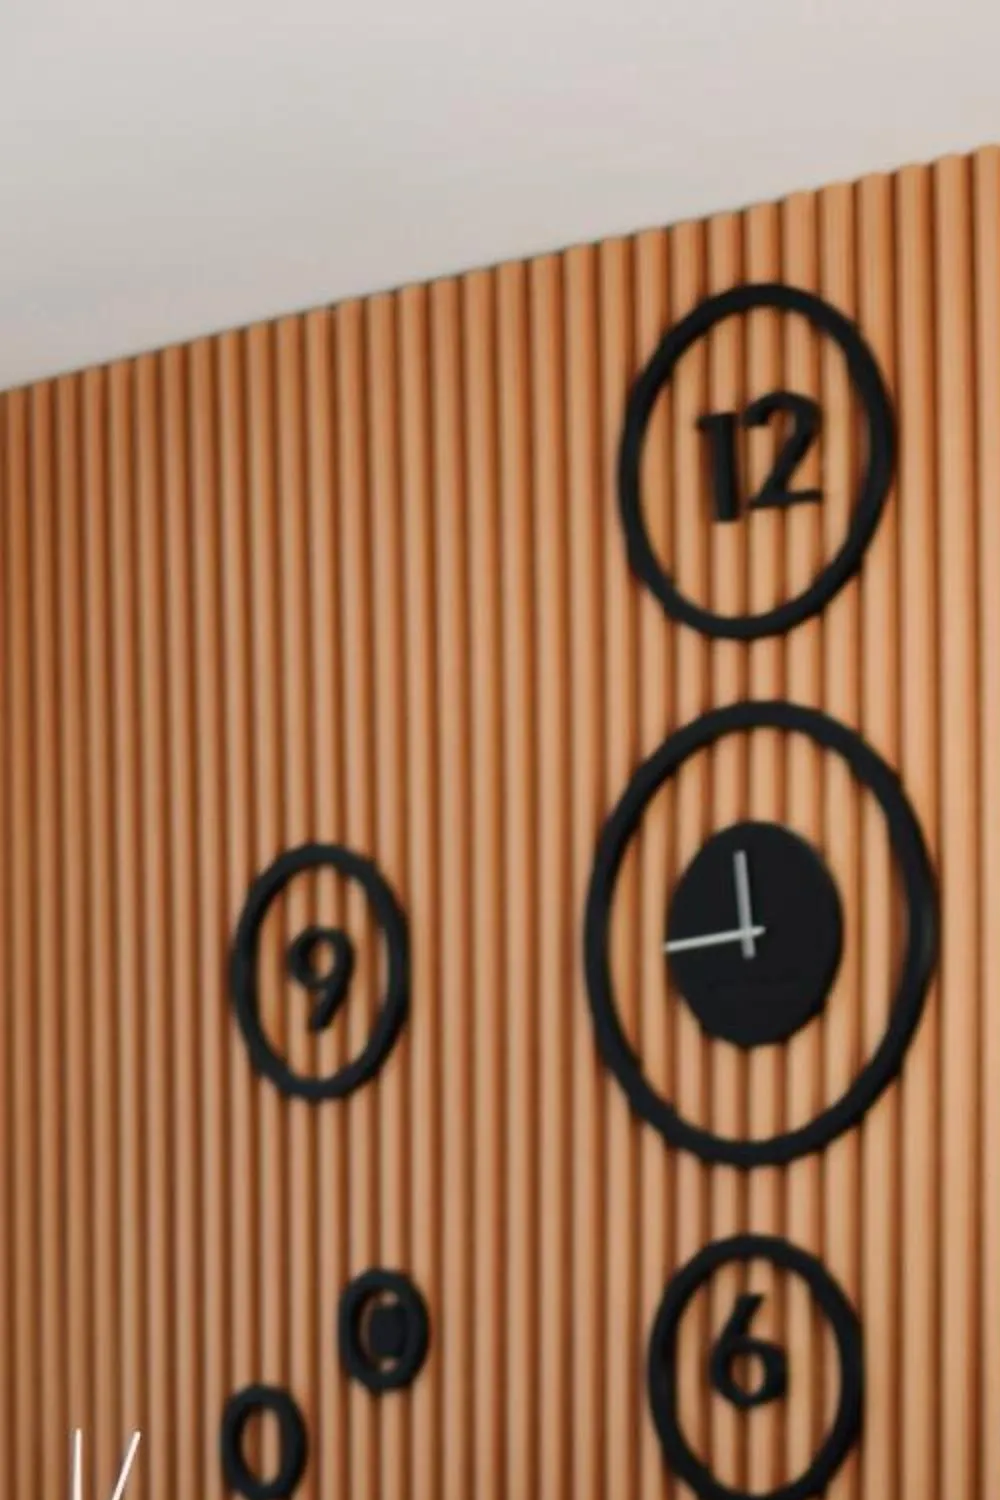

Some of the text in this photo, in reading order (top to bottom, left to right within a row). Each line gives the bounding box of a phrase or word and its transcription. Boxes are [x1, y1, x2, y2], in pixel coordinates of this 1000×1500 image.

[696, 391, 823, 522] 12
[286, 926, 356, 1033] 9
[711, 1293, 789, 1410] 6
